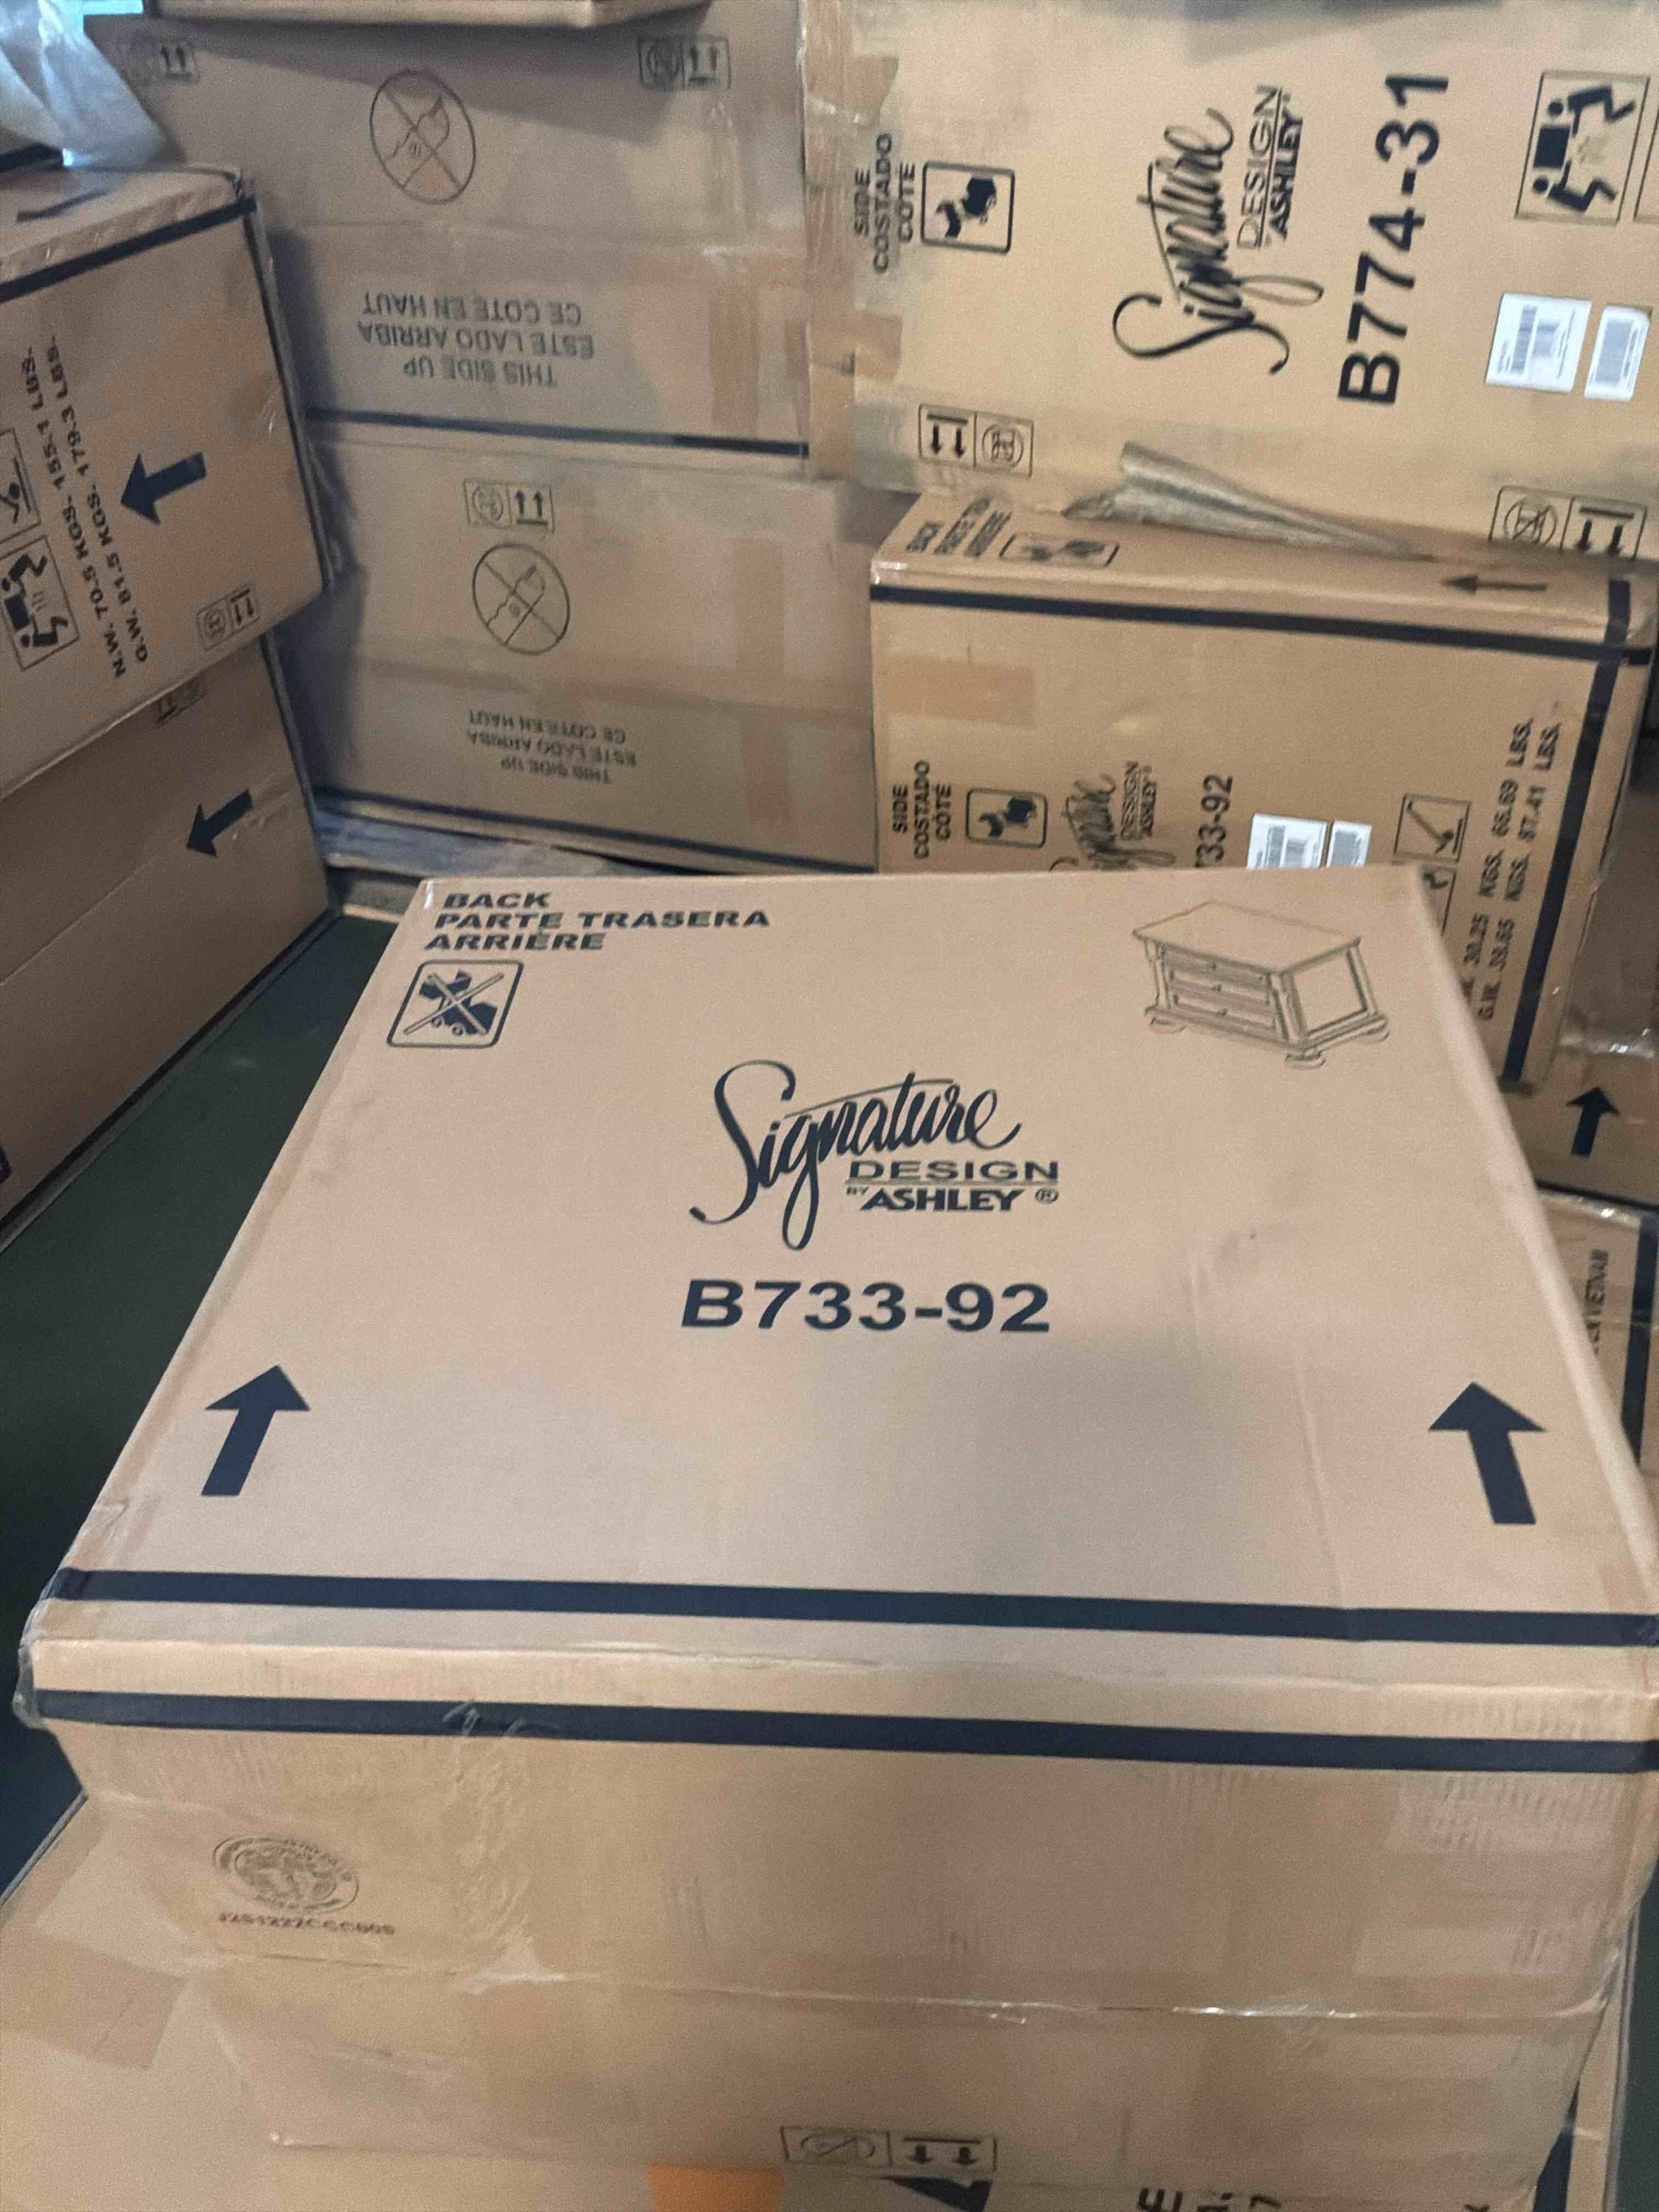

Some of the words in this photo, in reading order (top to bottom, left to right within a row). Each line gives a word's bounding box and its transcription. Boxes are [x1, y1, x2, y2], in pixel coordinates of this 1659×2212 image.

[1237, 84, 1282, 249] DESIGN
[1269, 112, 1303, 240] ASHLEY
[854, 168, 870, 236] SIDE
[873, 133, 892, 273] COSTADO
[1113, 108, 1324, 375] Signature
[1337, 74, 1448, 404] B774-31
[362, 292, 426, 317] HAUT
[358, 321, 447, 349] ARRIBA
[456, 330, 523, 352] LADO
[532, 332, 594, 359] ESTE
[403, 356, 435, 378] UP
[442, 356, 494, 382] SIDE
[504, 361, 555, 386] THIS
[82, 566, 107, 620] 70.5
[107, 552, 131, 604] 81.5
[104, 622, 125, 678] N.W.
[892, 784, 907, 833] SIDE
[914, 760, 930, 859] COSTADO
[435, 912, 563, 929] PARTE
[578, 911, 769, 928] TRASERA
[443, 892, 551, 909] BACK
[689, 1060, 1021, 1250] Signature
[849, 1160, 1059, 1180] DESIGN
[861, 1188, 1025, 1211] ASHLEY
[681, 1279, 1049, 1333] B733-92
